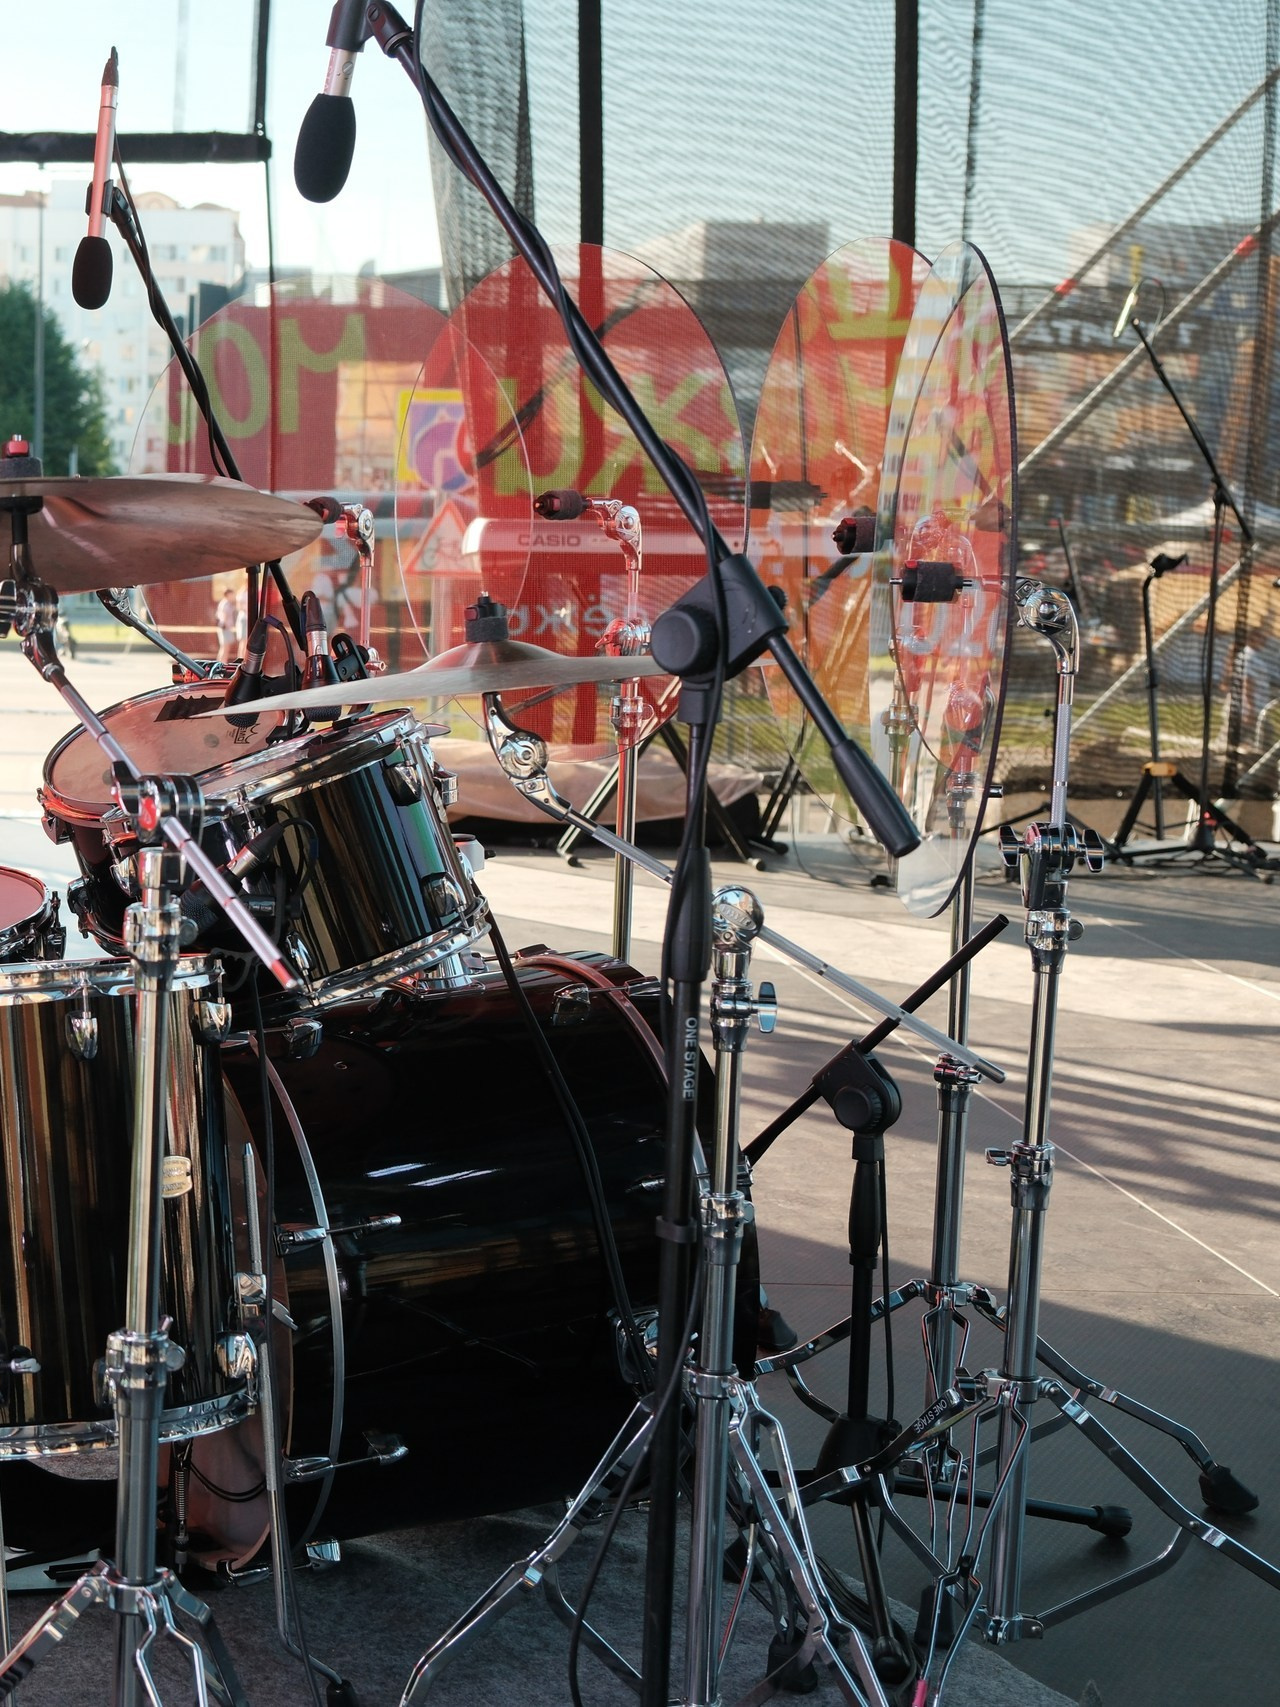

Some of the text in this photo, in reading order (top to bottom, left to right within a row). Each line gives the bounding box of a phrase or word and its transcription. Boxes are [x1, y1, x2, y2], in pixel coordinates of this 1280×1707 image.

[517, 535, 582, 548] CASIO
[682, 1017, 698, 1099] ONE STAGE
[913, 1399, 948, 1434] ONE STAGE
